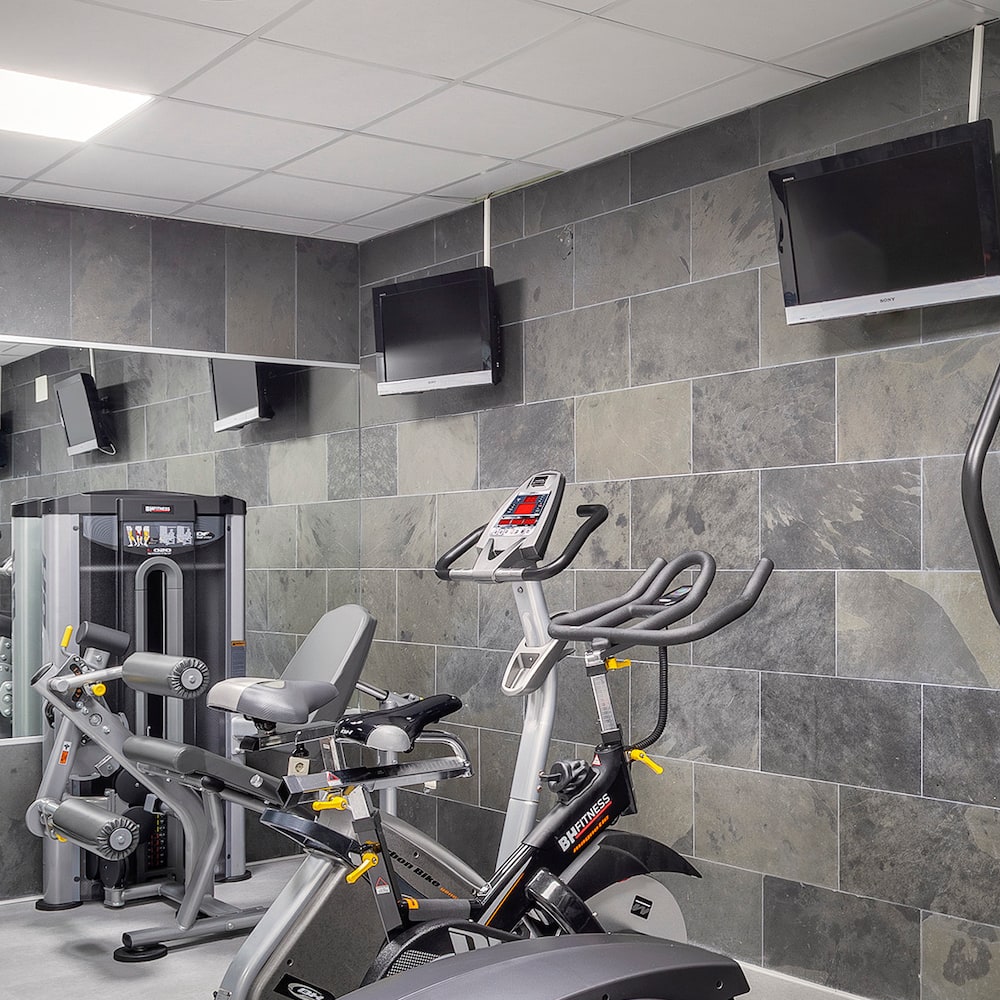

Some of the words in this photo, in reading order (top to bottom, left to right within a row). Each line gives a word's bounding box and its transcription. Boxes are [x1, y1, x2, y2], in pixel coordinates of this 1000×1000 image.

[879, 296, 896, 304] SONY
[388, 849, 414, 870] bon
[413, 866, 441, 887] Bike
